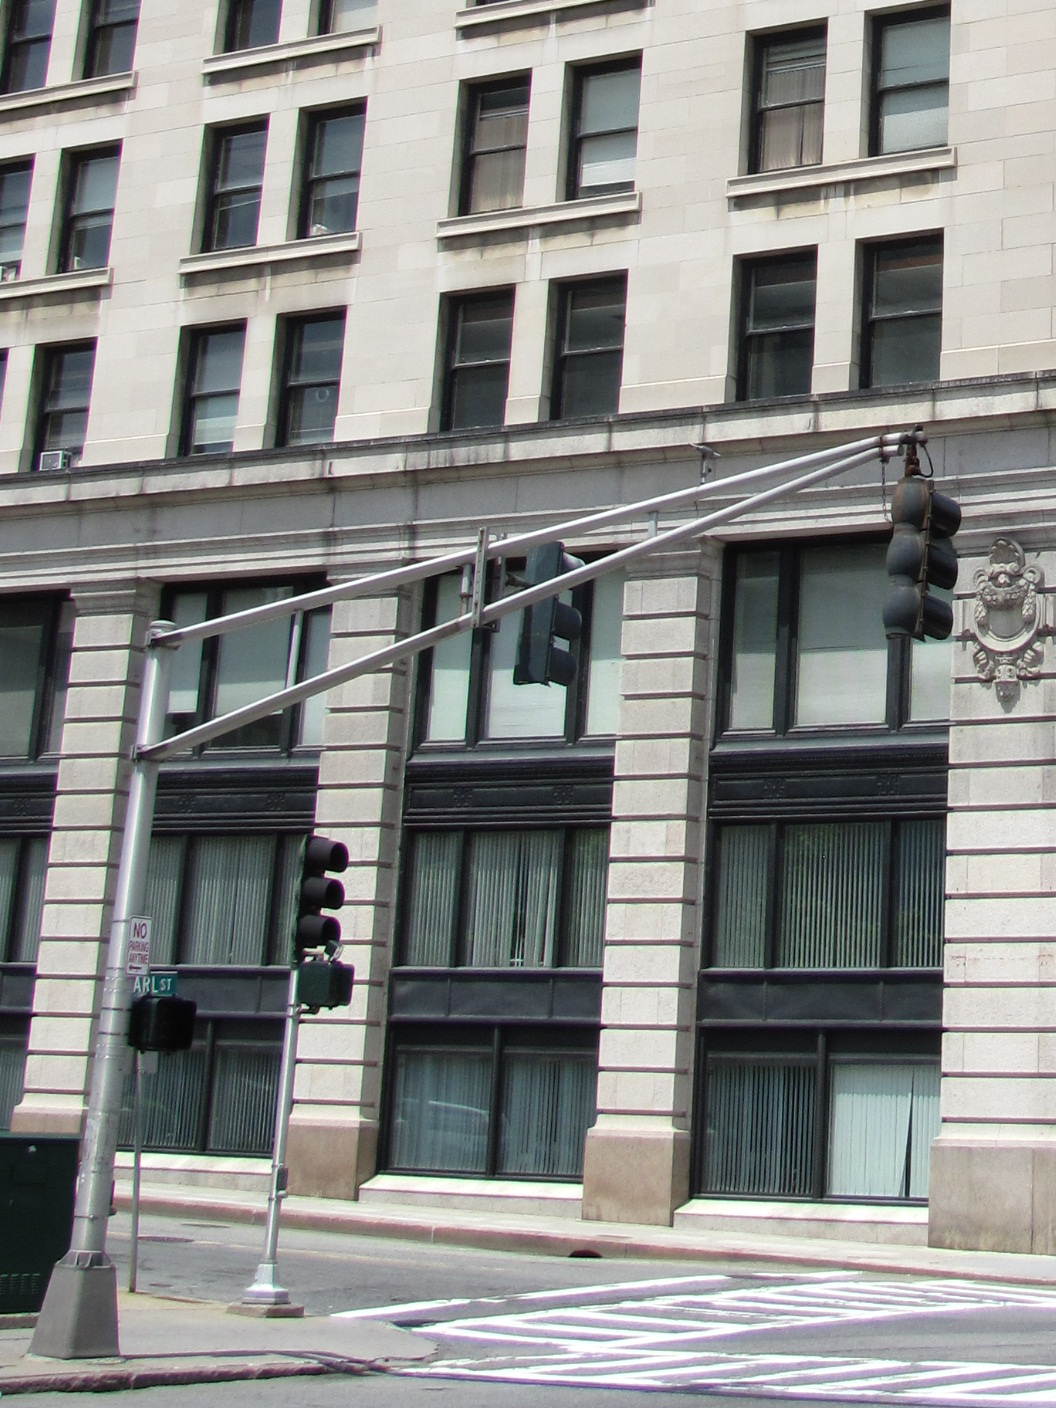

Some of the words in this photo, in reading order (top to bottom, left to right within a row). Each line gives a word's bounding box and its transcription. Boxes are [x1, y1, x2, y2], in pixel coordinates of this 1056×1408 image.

[133, 922, 148, 939] NO
[130, 940, 149, 953] PARKING
[160, 978, 173, 991] ST
